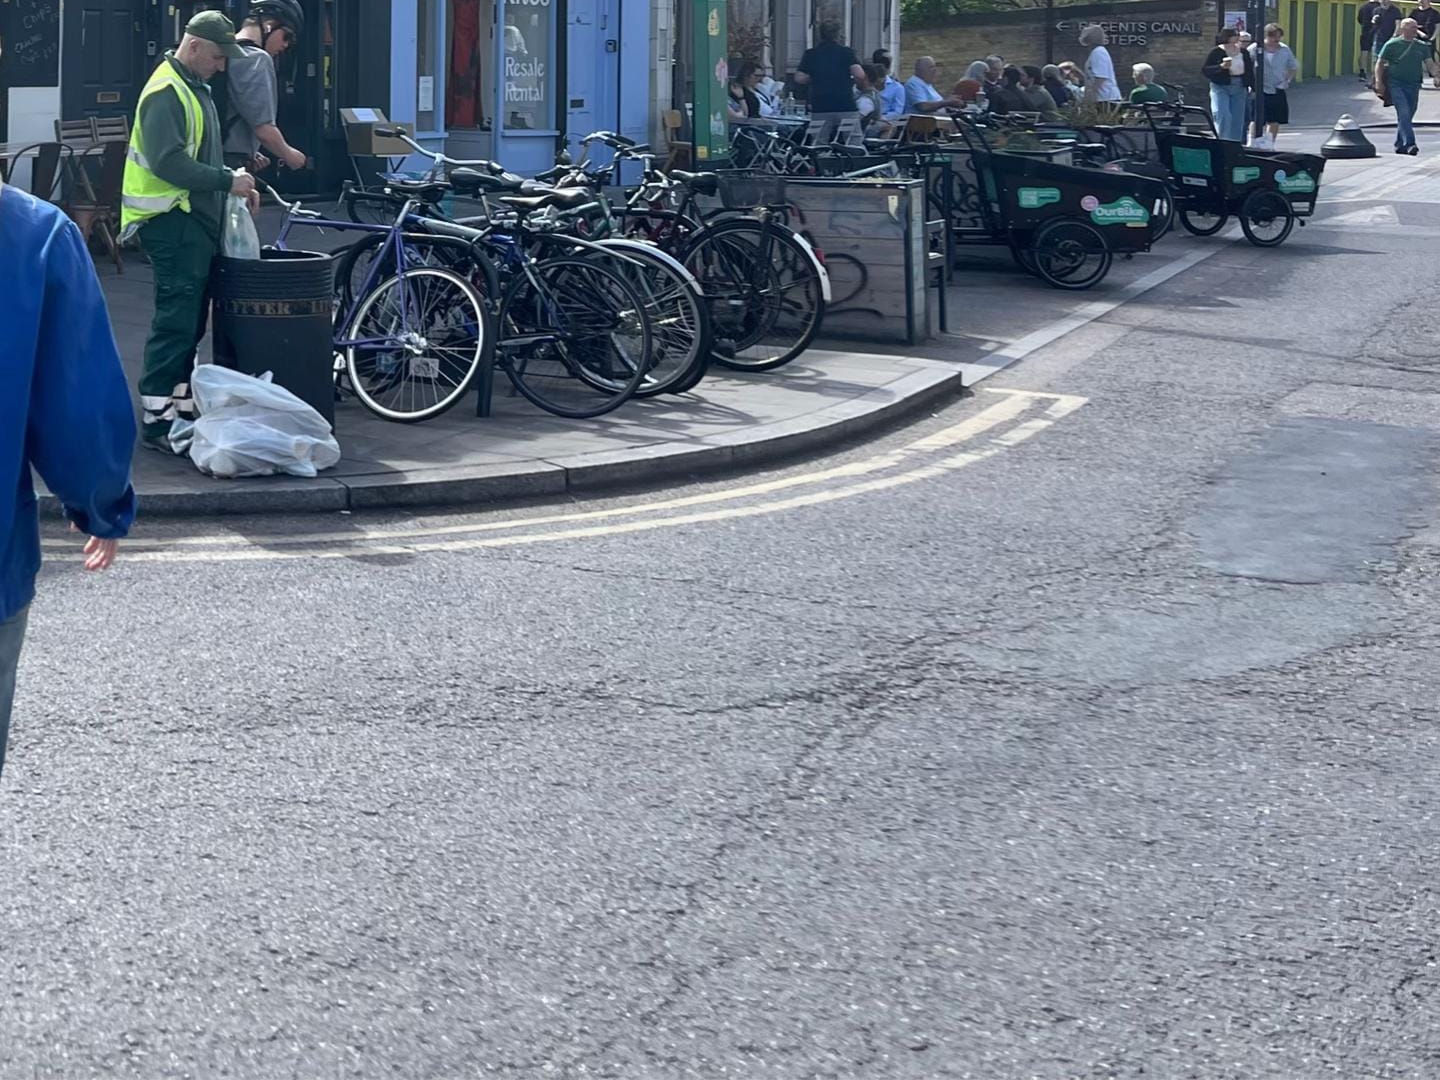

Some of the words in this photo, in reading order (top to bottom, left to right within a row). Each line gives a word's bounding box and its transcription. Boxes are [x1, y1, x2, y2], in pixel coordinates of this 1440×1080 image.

[1078, 21, 1147, 33] RGENTS
[1151, 22, 1200, 34] CANAL
[1103, 34, 1147, 46] STEPS
[505, 56, 545, 77] Resale
[505, 81, 544, 102] Rental
